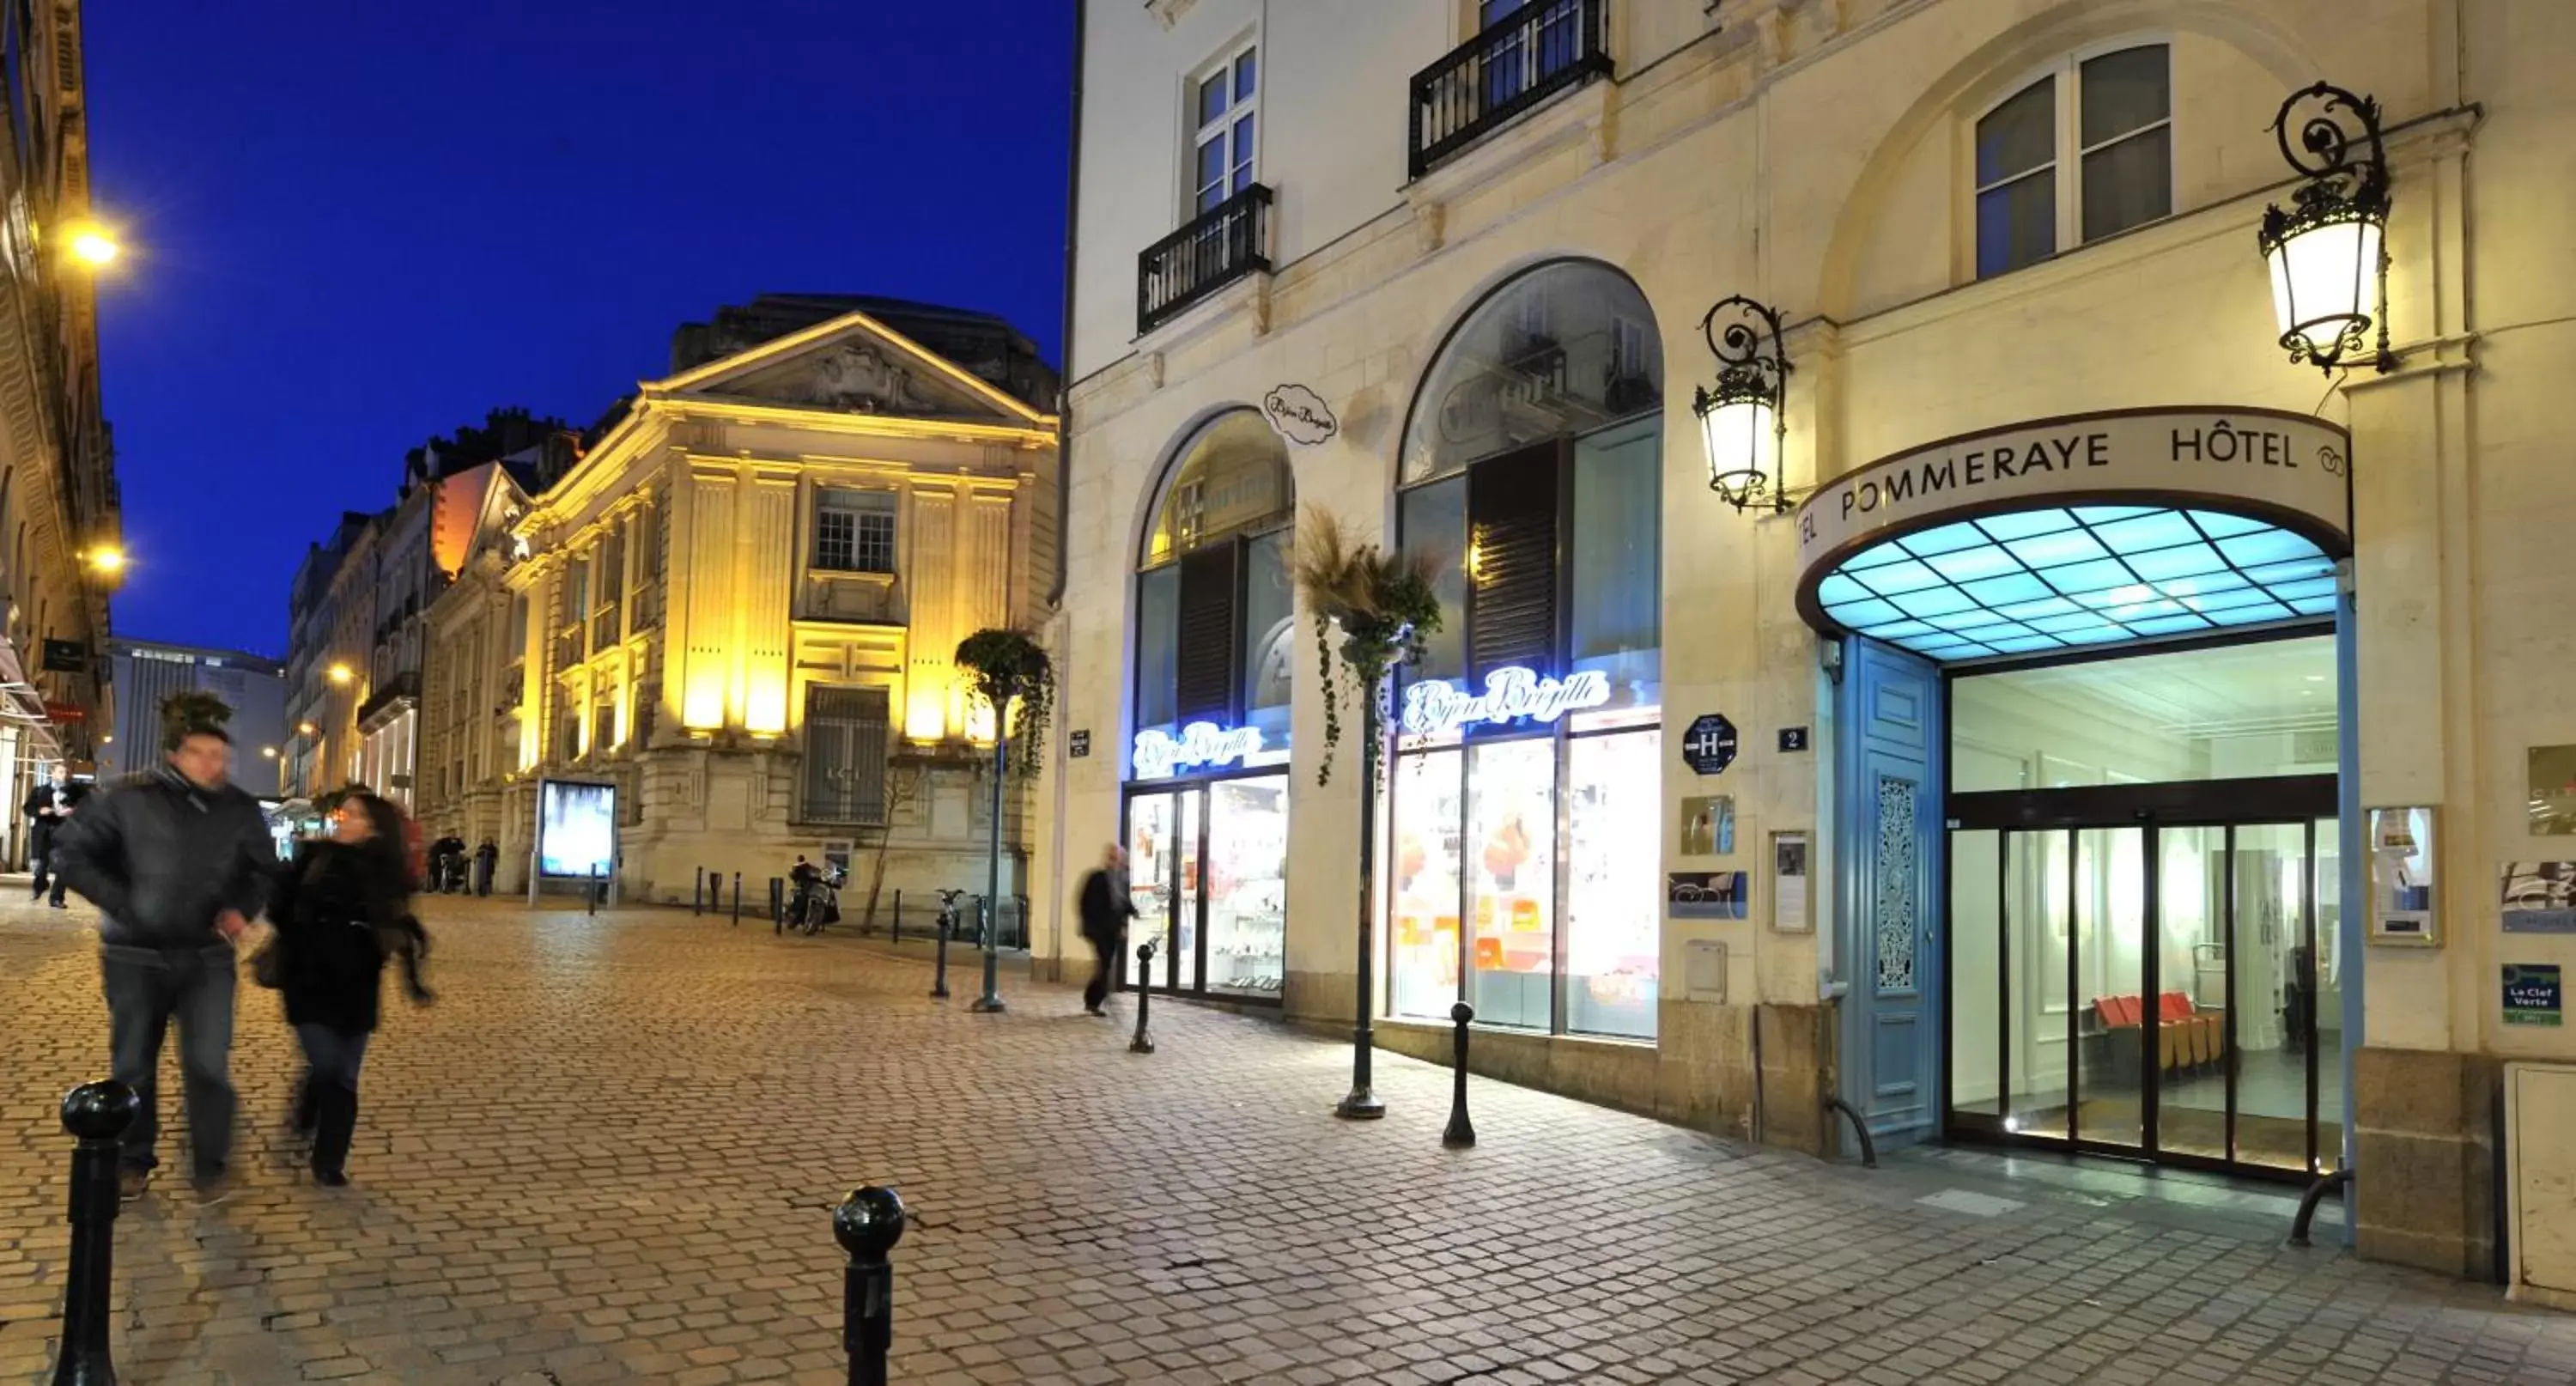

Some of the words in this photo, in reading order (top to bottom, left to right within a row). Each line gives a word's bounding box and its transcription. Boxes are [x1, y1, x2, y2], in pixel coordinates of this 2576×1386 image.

[1841, 434, 2109, 521] POMMERAYE
[2172, 419, 2298, 468] HÔTEL
[1701, 733, 1718, 757] H
[1789, 731, 1799, 748] 2
[2510, 988, 2525, 997] La
